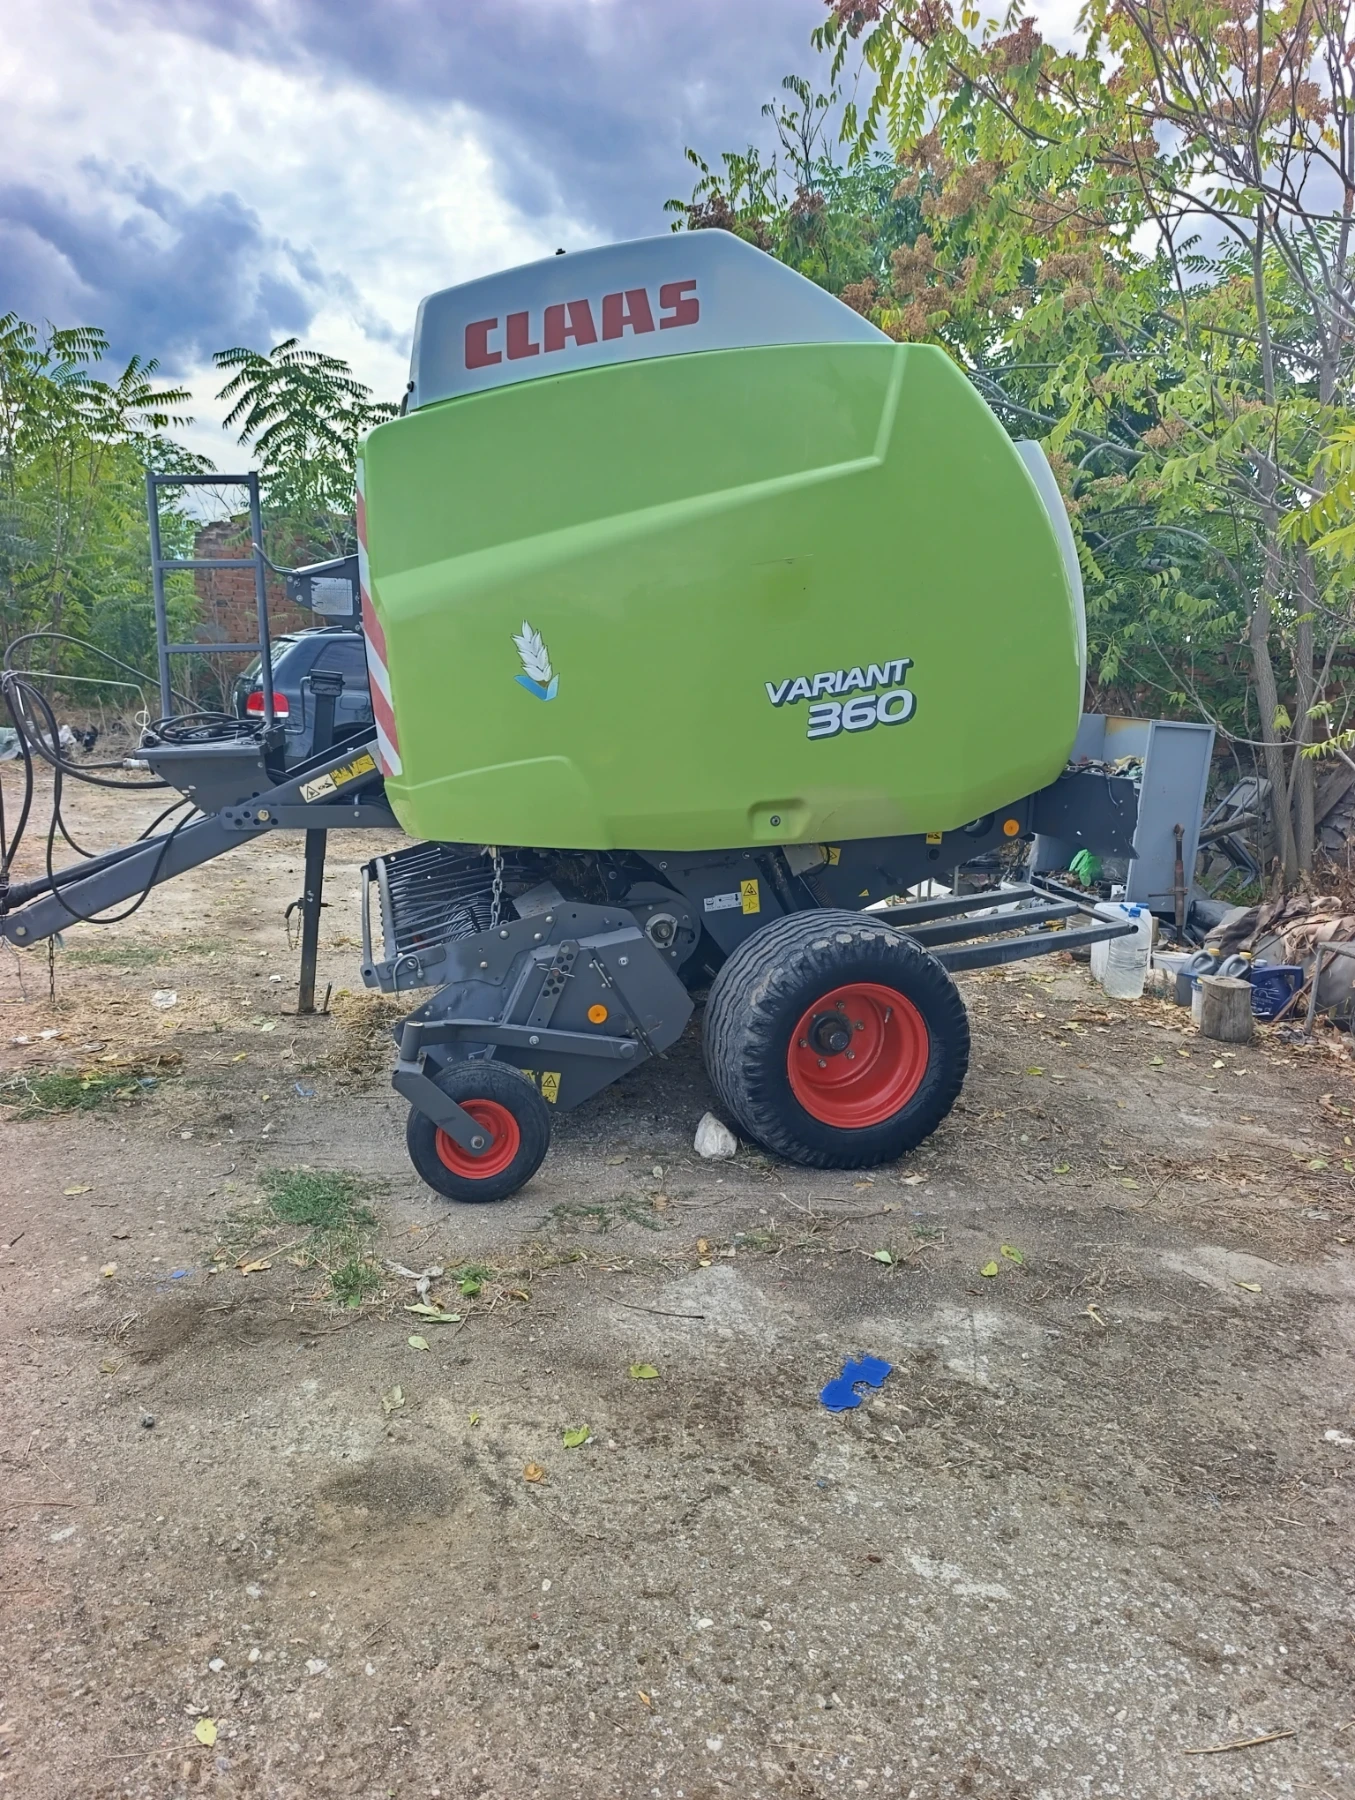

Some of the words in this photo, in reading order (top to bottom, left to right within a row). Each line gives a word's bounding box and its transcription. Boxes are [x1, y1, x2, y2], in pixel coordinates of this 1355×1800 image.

[465, 279, 699, 369] CLAAS
[765, 657, 913, 707] VARIANT
[806, 689, 916, 740] 360
